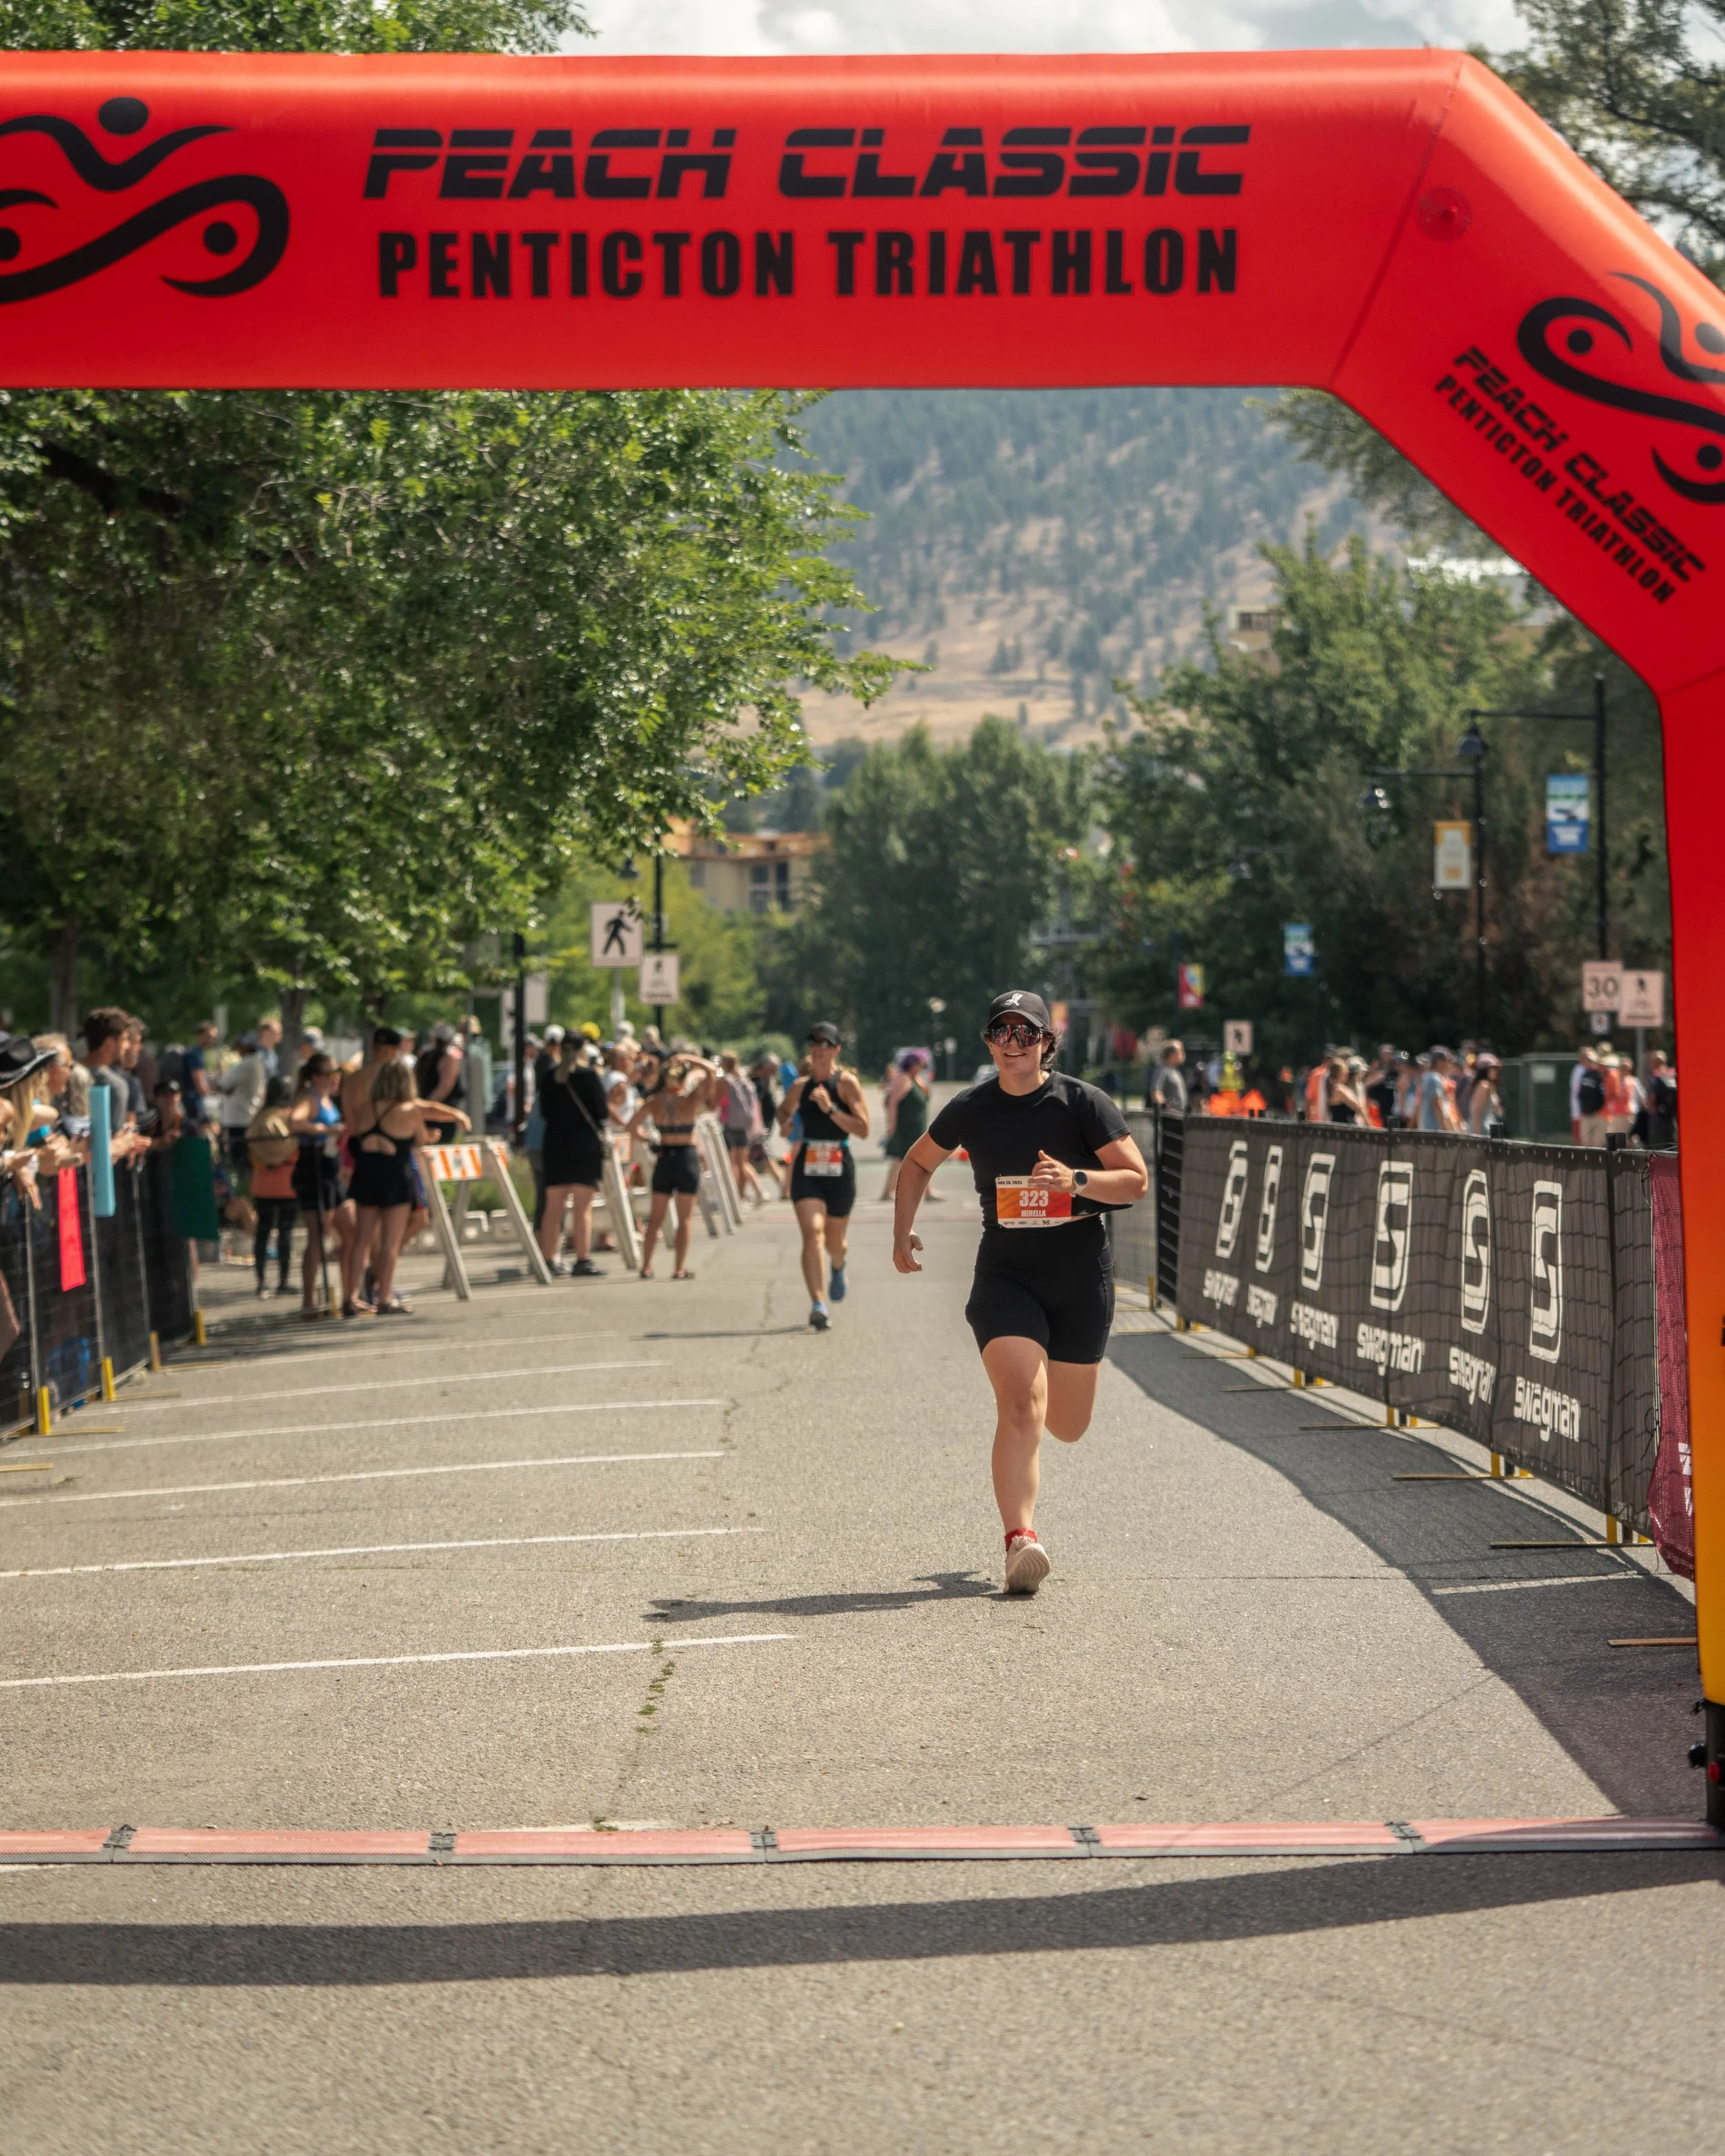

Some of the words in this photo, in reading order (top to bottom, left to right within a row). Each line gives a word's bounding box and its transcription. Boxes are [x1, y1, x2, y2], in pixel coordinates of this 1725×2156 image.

[362, 128, 738, 199] PEACH
[778, 125, 1251, 199] CLASSIC
[378, 230, 794, 299] PENTICTON
[827, 228, 1237, 296] TRIATHLON
[1435, 374, 1558, 493] PENTICTON
[1555, 486, 1676, 604] TRIATHLON
[1453, 346, 1569, 453] PEACH
[1564, 452, 1706, 583] CLASSIC
[1588, 976, 1619, 998] 30
[1019, 1190, 1049, 1207] 323
[1514, 1376, 1581, 1443] swagman
